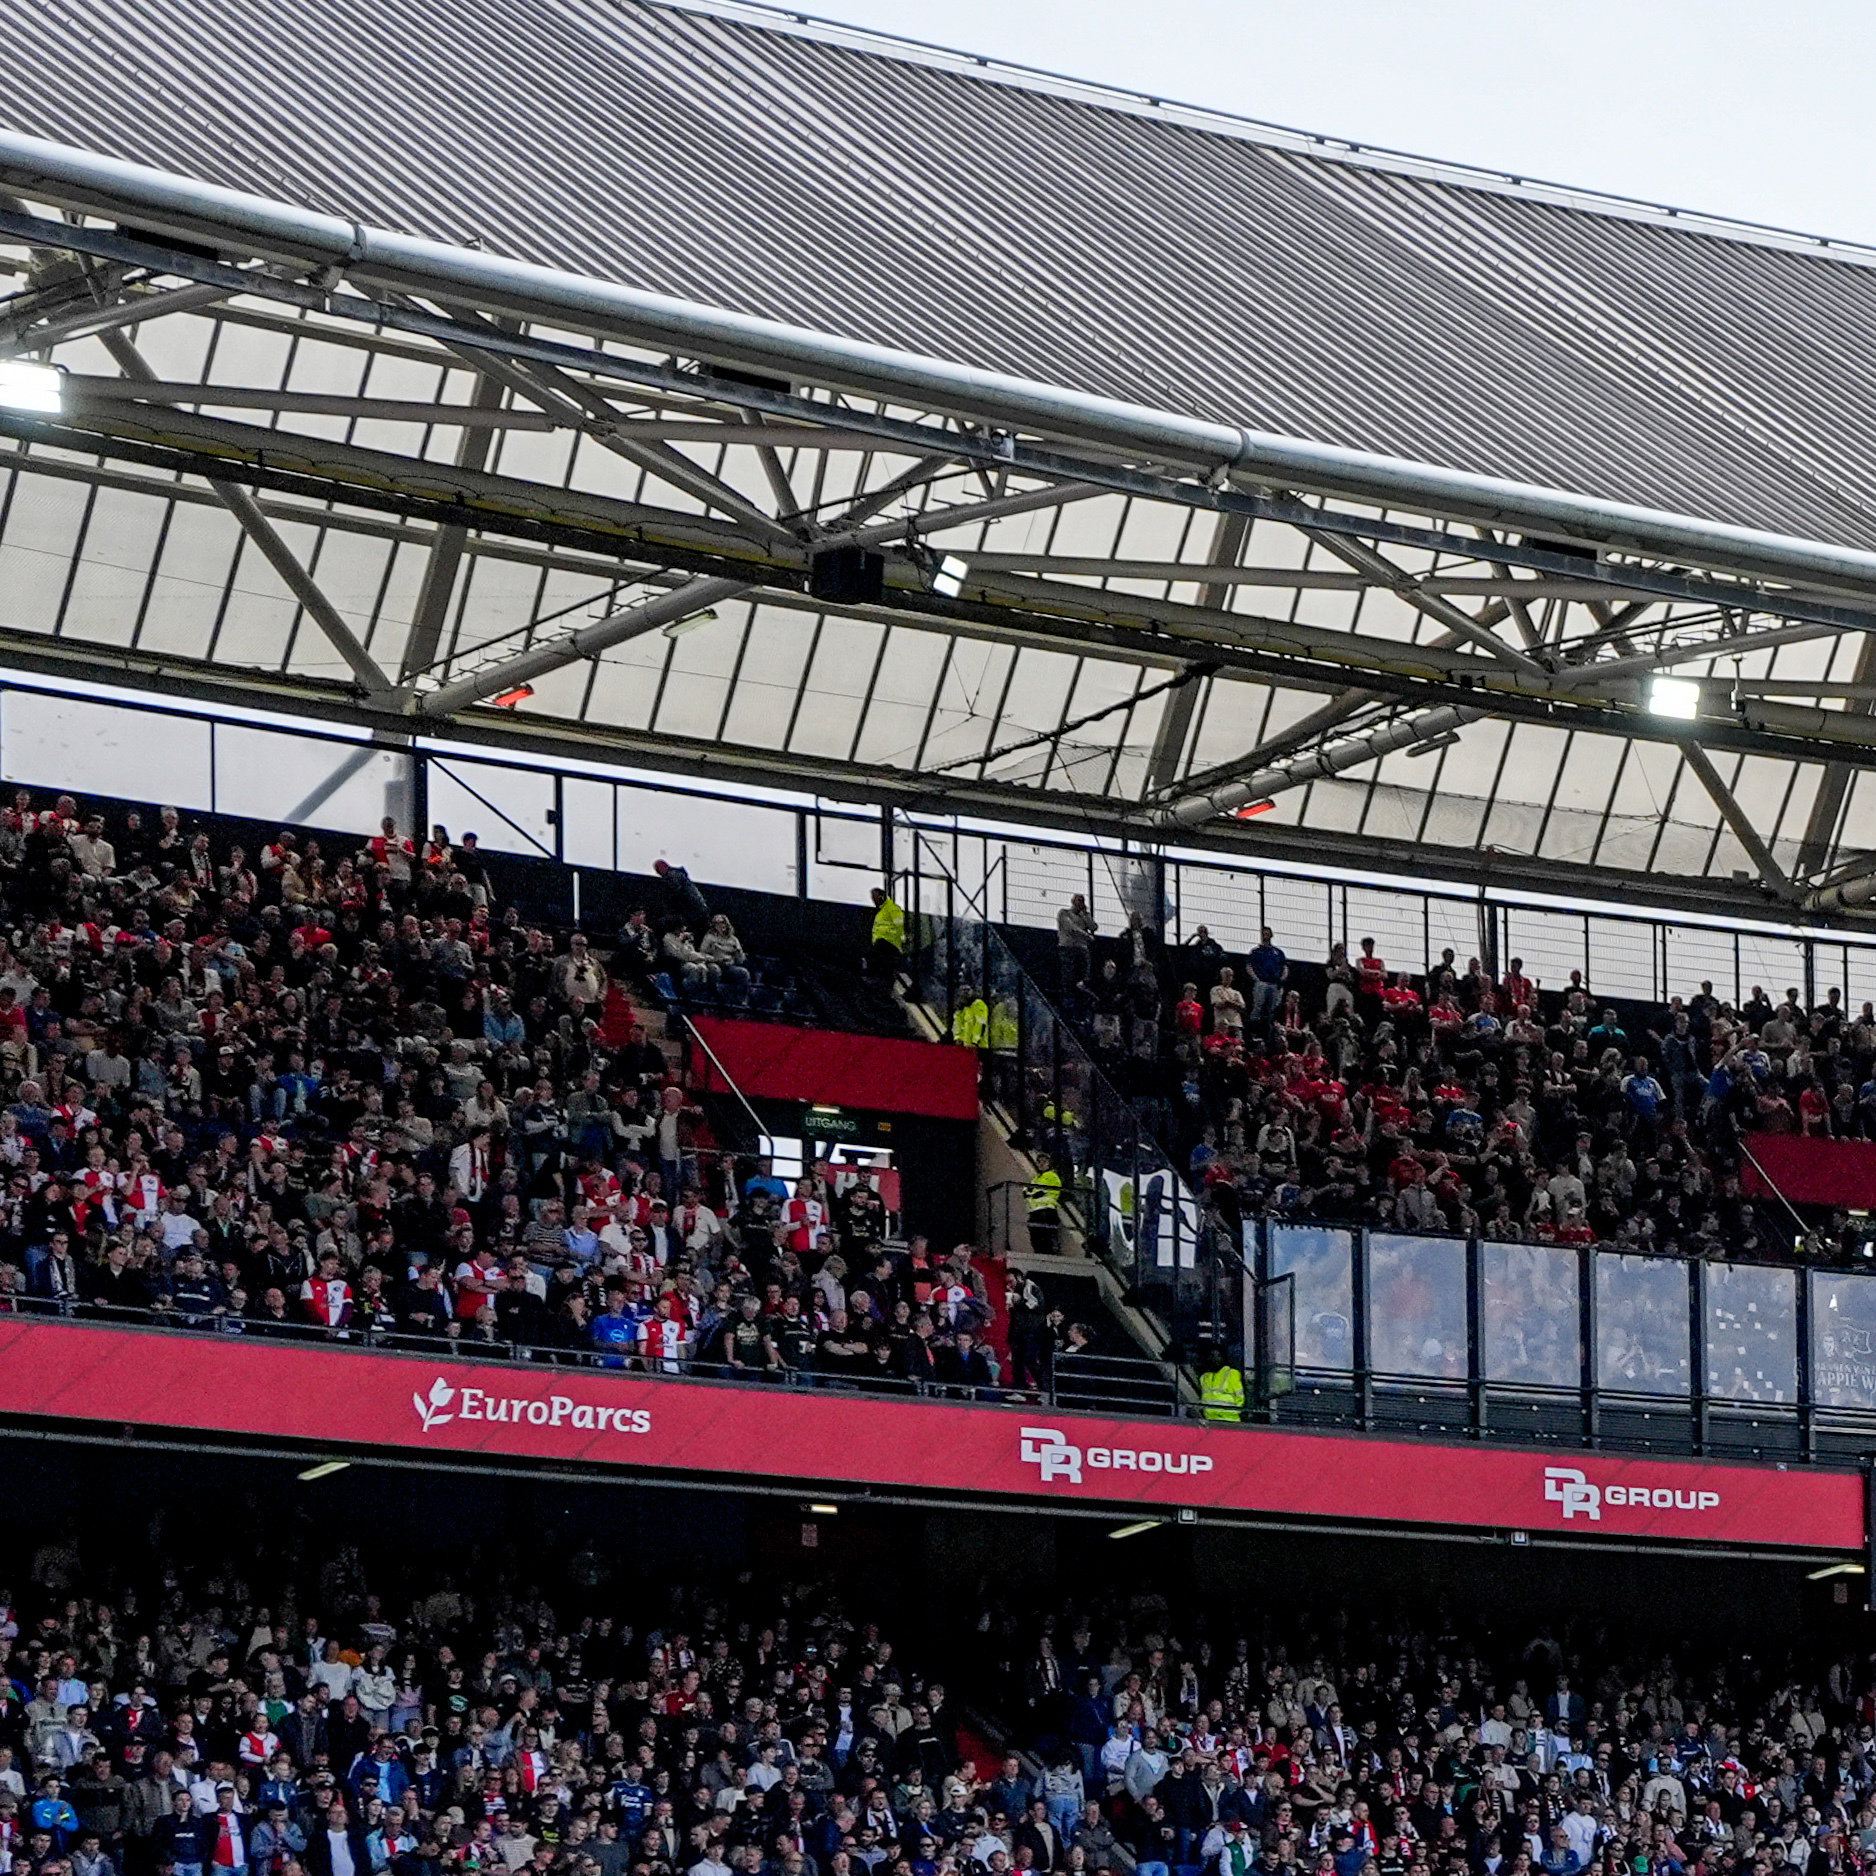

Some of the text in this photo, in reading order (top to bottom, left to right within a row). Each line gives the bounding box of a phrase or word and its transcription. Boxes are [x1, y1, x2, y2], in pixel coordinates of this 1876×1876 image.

[805, 1116, 857, 1132] UITGANG
[458, 1387, 651, 1434] EuroParcs
[1087, 1447, 1213, 1475] GROUP
[1605, 1485, 1720, 1510] GROUP
